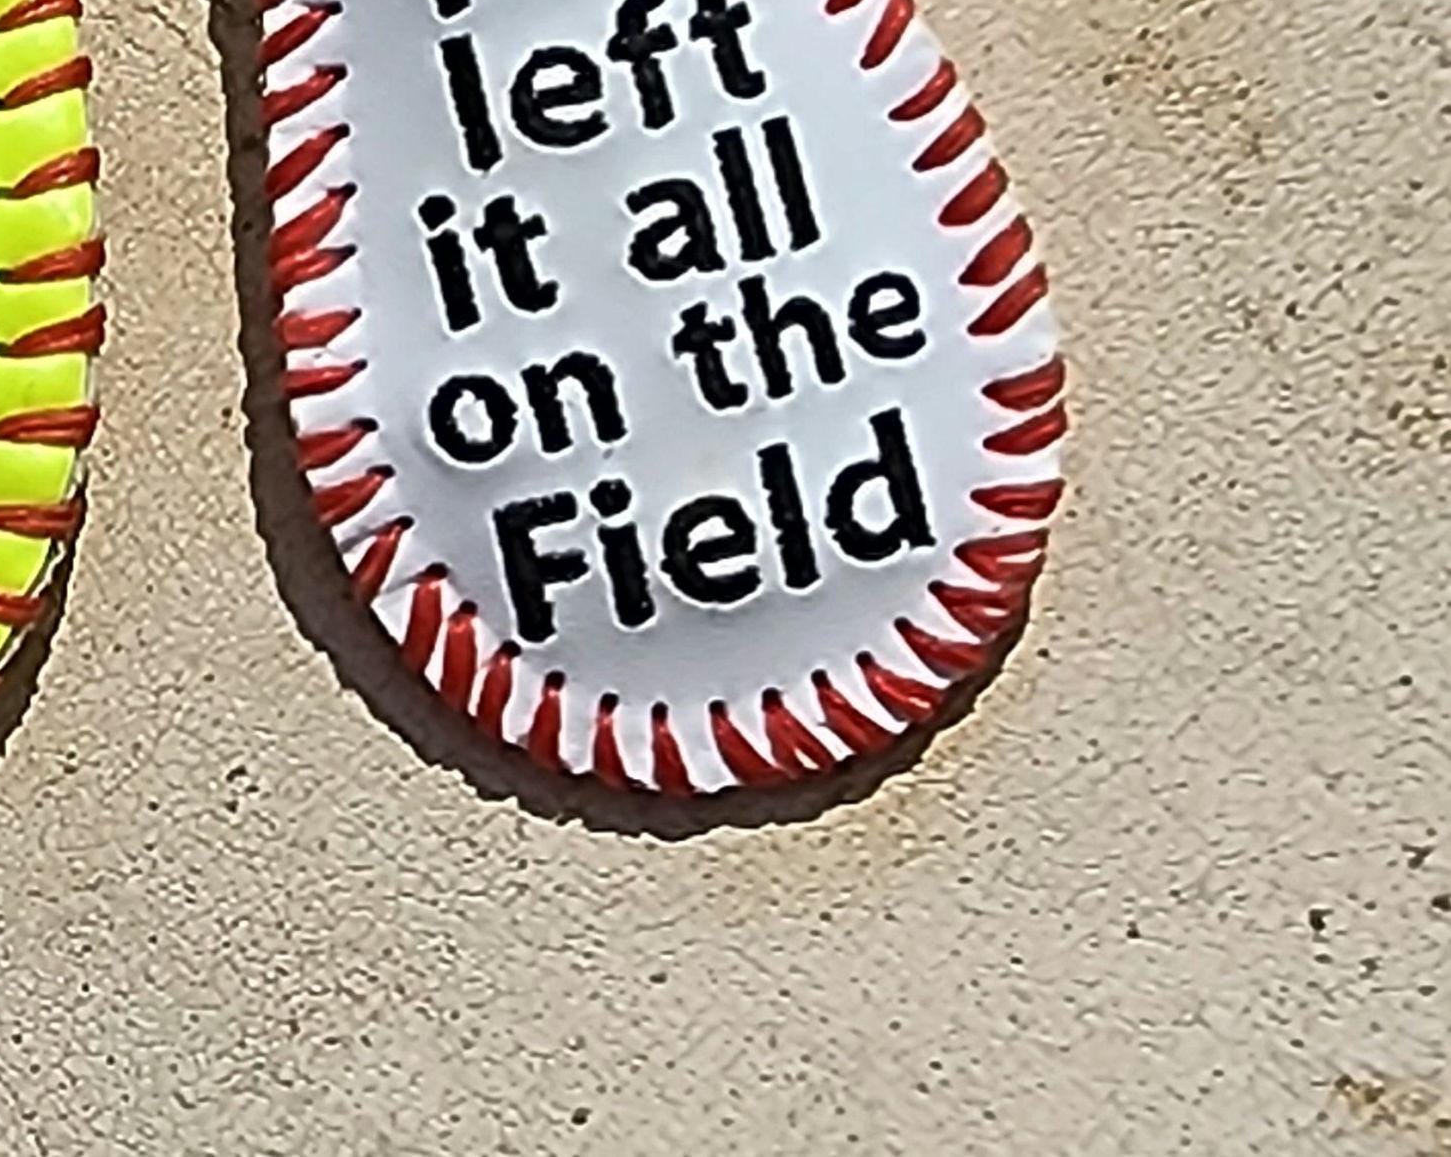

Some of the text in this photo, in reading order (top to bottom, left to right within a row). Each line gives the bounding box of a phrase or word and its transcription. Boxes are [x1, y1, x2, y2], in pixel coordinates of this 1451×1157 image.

[417, 115, 821, 333] it all
[428, 271, 927, 464] on the
[491, 407, 937, 644] Field
